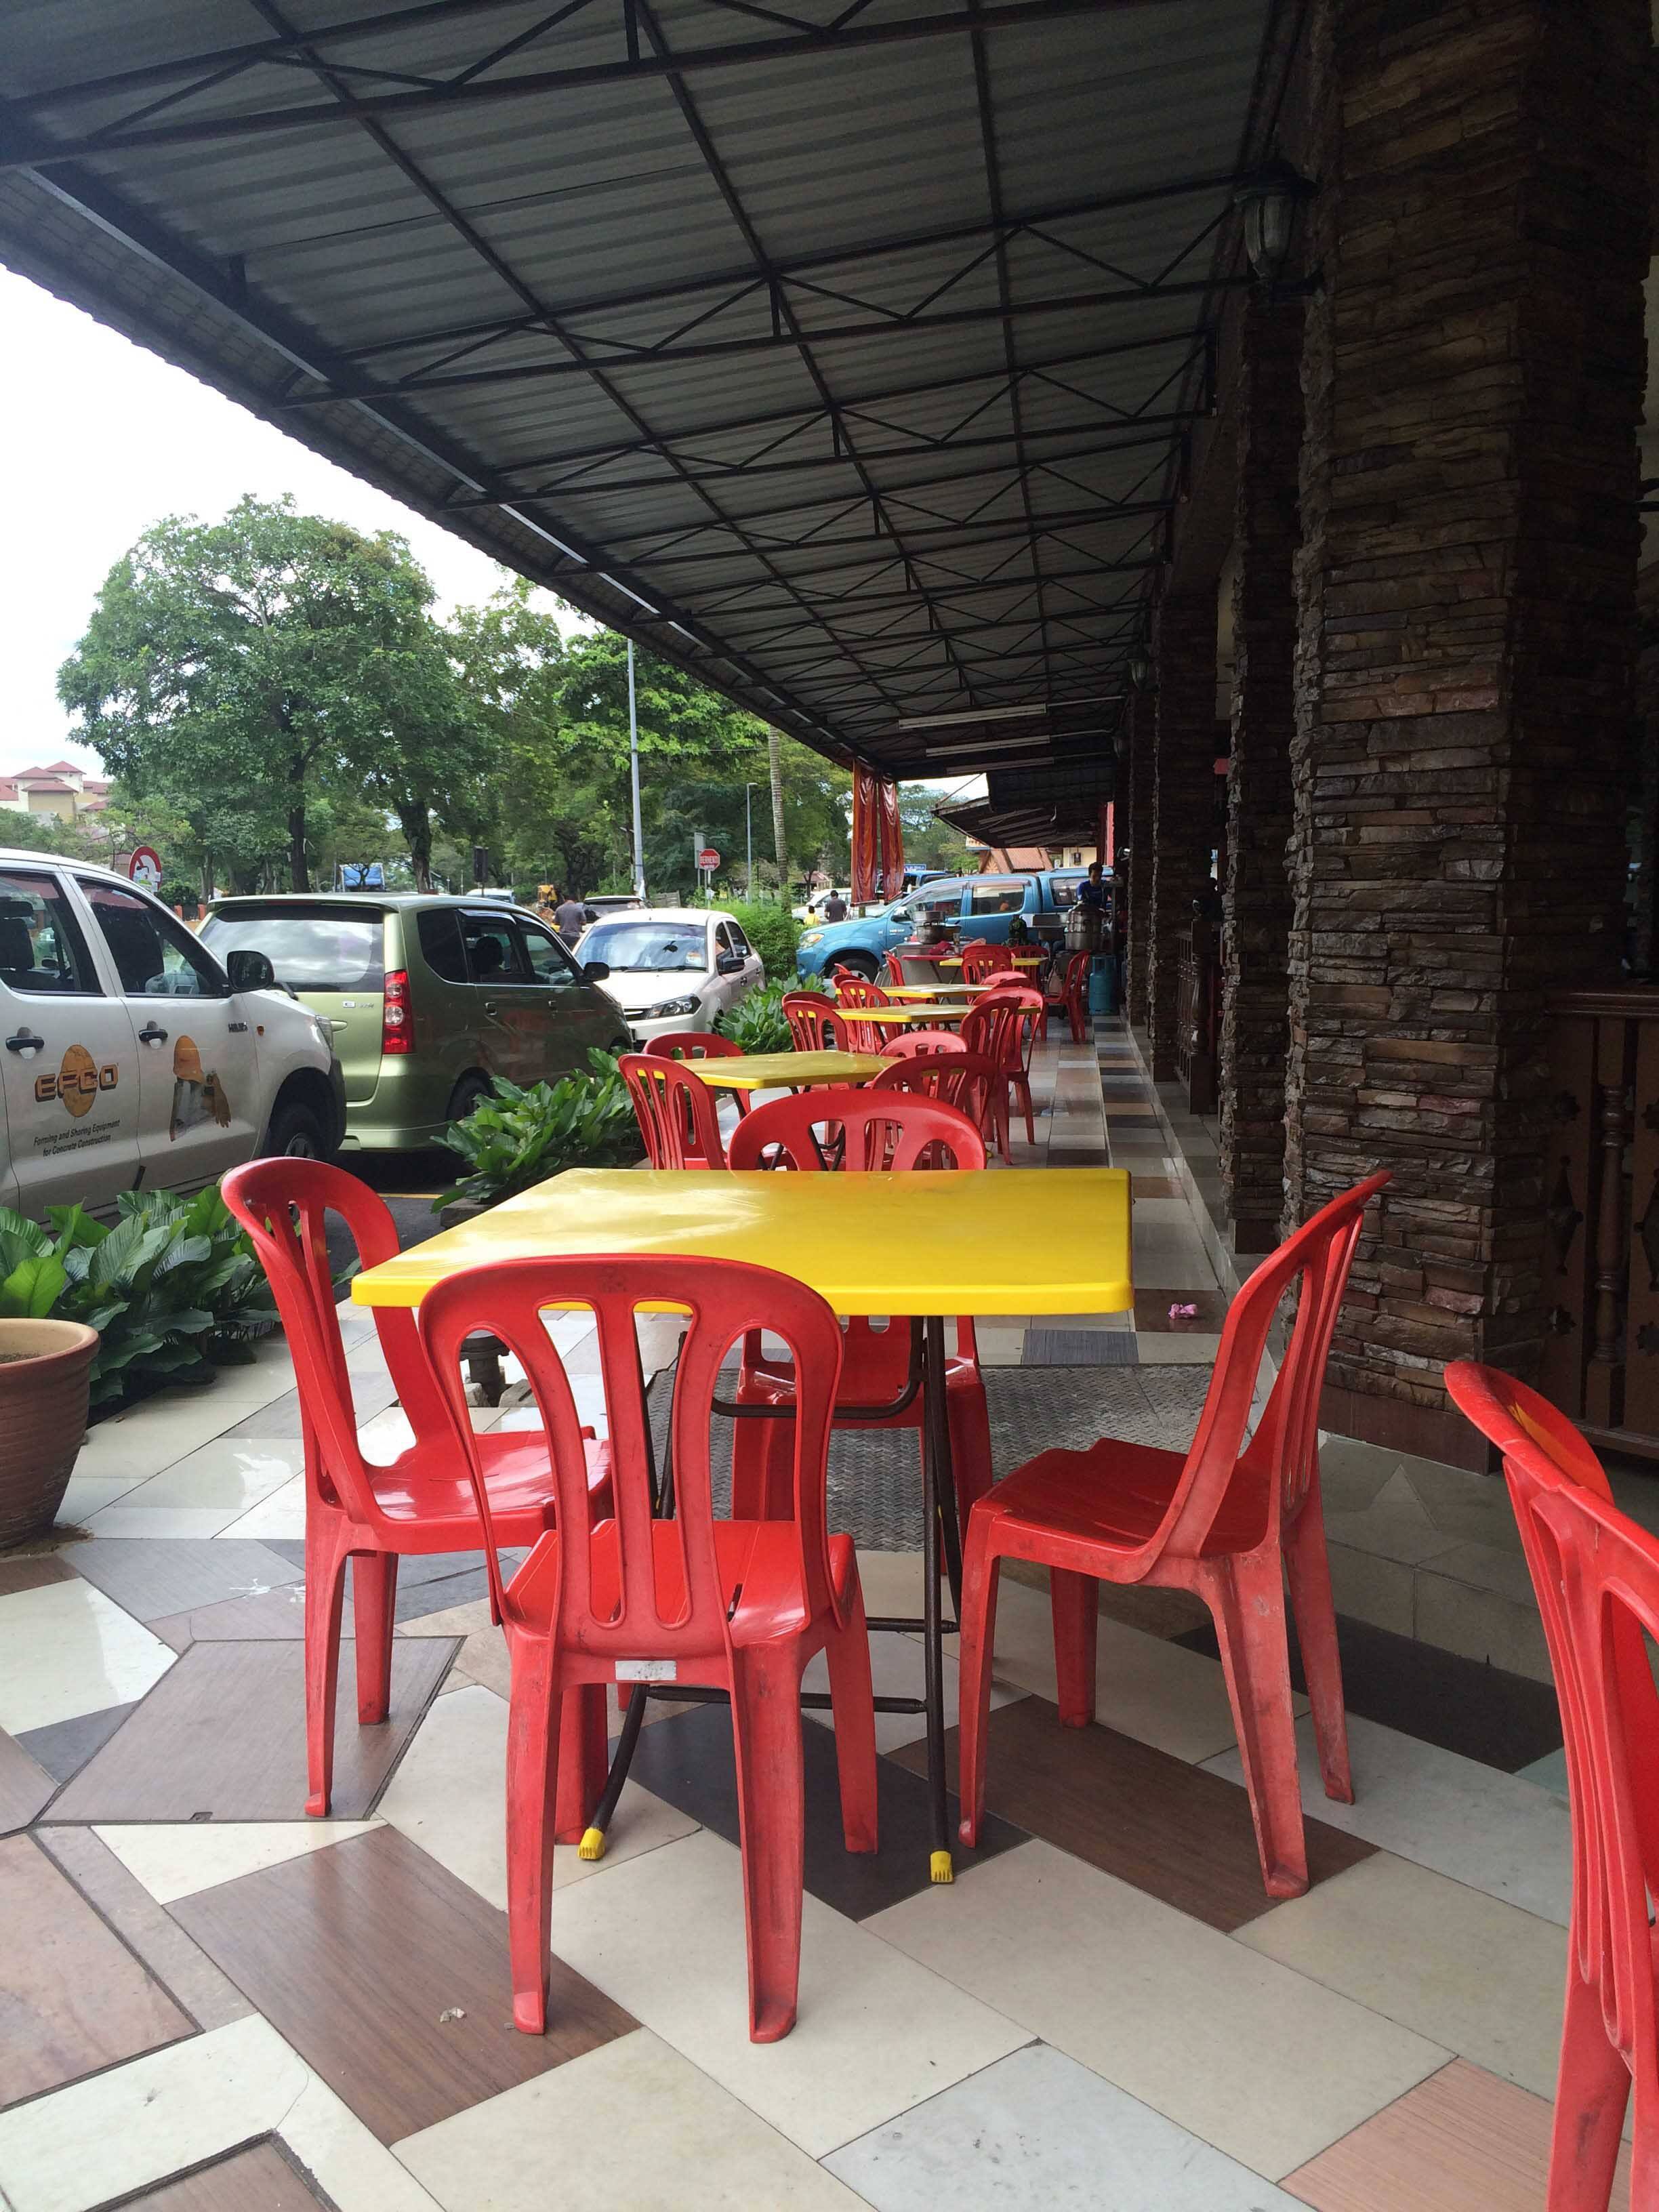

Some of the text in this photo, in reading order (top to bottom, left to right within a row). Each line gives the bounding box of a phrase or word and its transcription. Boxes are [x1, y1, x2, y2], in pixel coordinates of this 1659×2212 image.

[35, 1065, 119, 1103] EFCO
[34, 1134, 58, 1146] Forming
[59, 1130, 69, 1140] and
[93, 1120, 120, 1132] Equipment
[43, 1135, 111, 1158] for Concrete Construction
